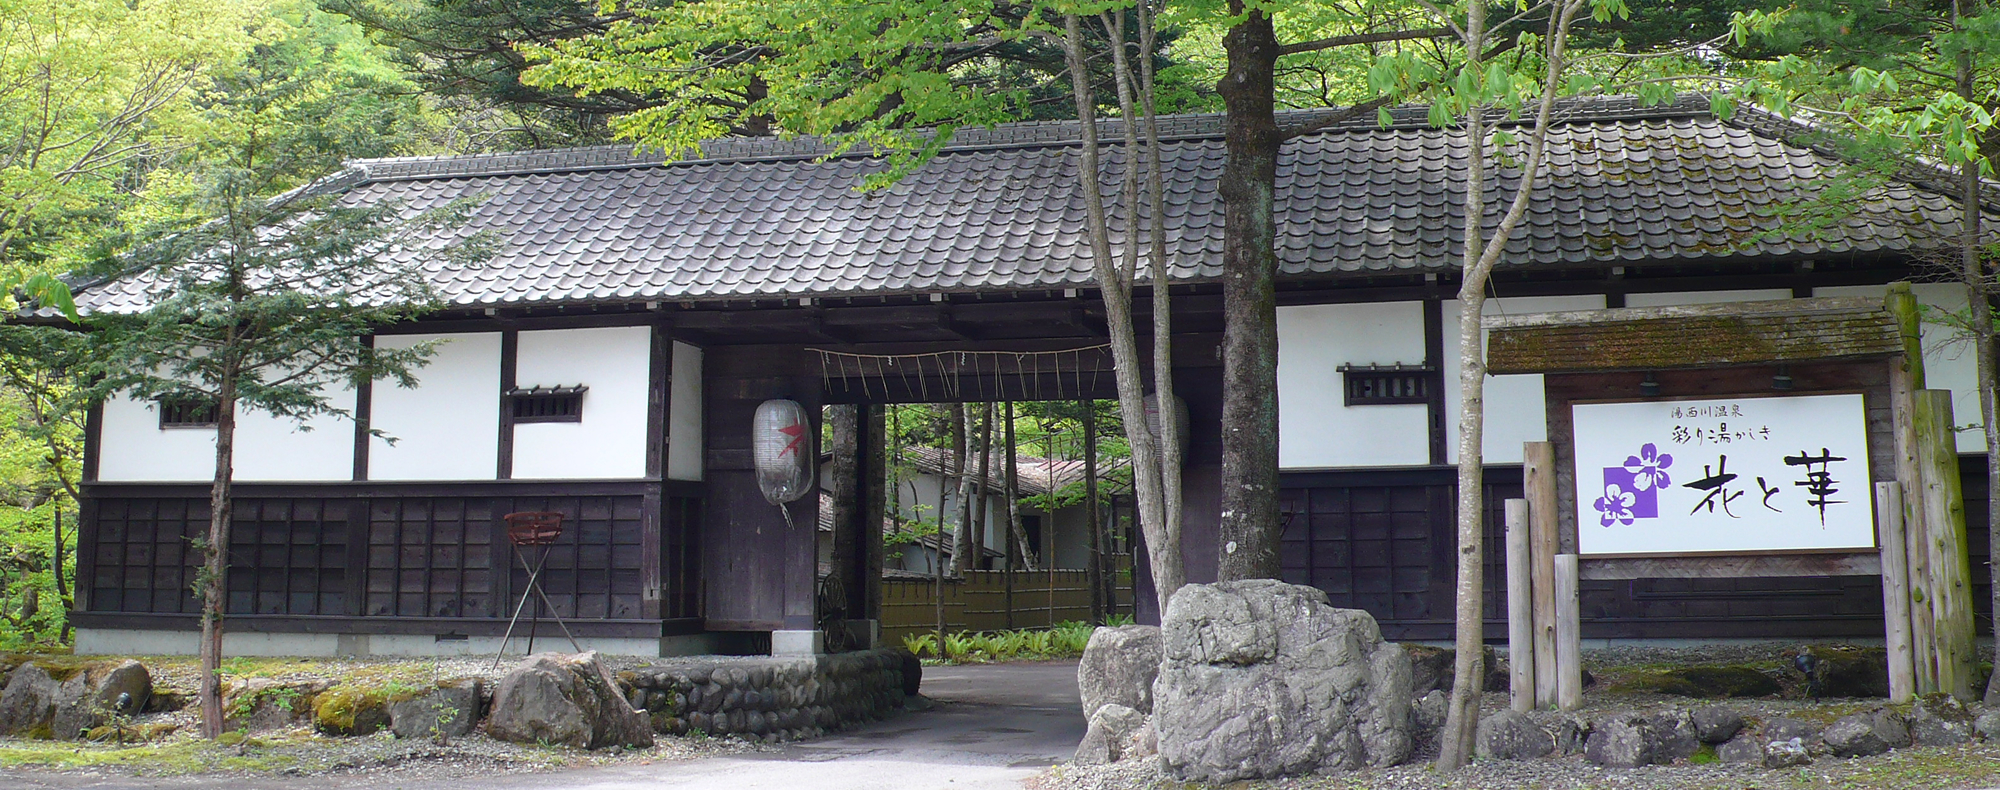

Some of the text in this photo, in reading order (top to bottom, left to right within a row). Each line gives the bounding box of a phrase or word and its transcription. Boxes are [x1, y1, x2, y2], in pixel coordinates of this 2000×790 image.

[1671, 403, 1744, 419] 湯西川温泉
[1682, 447, 1849, 531] 花と華
